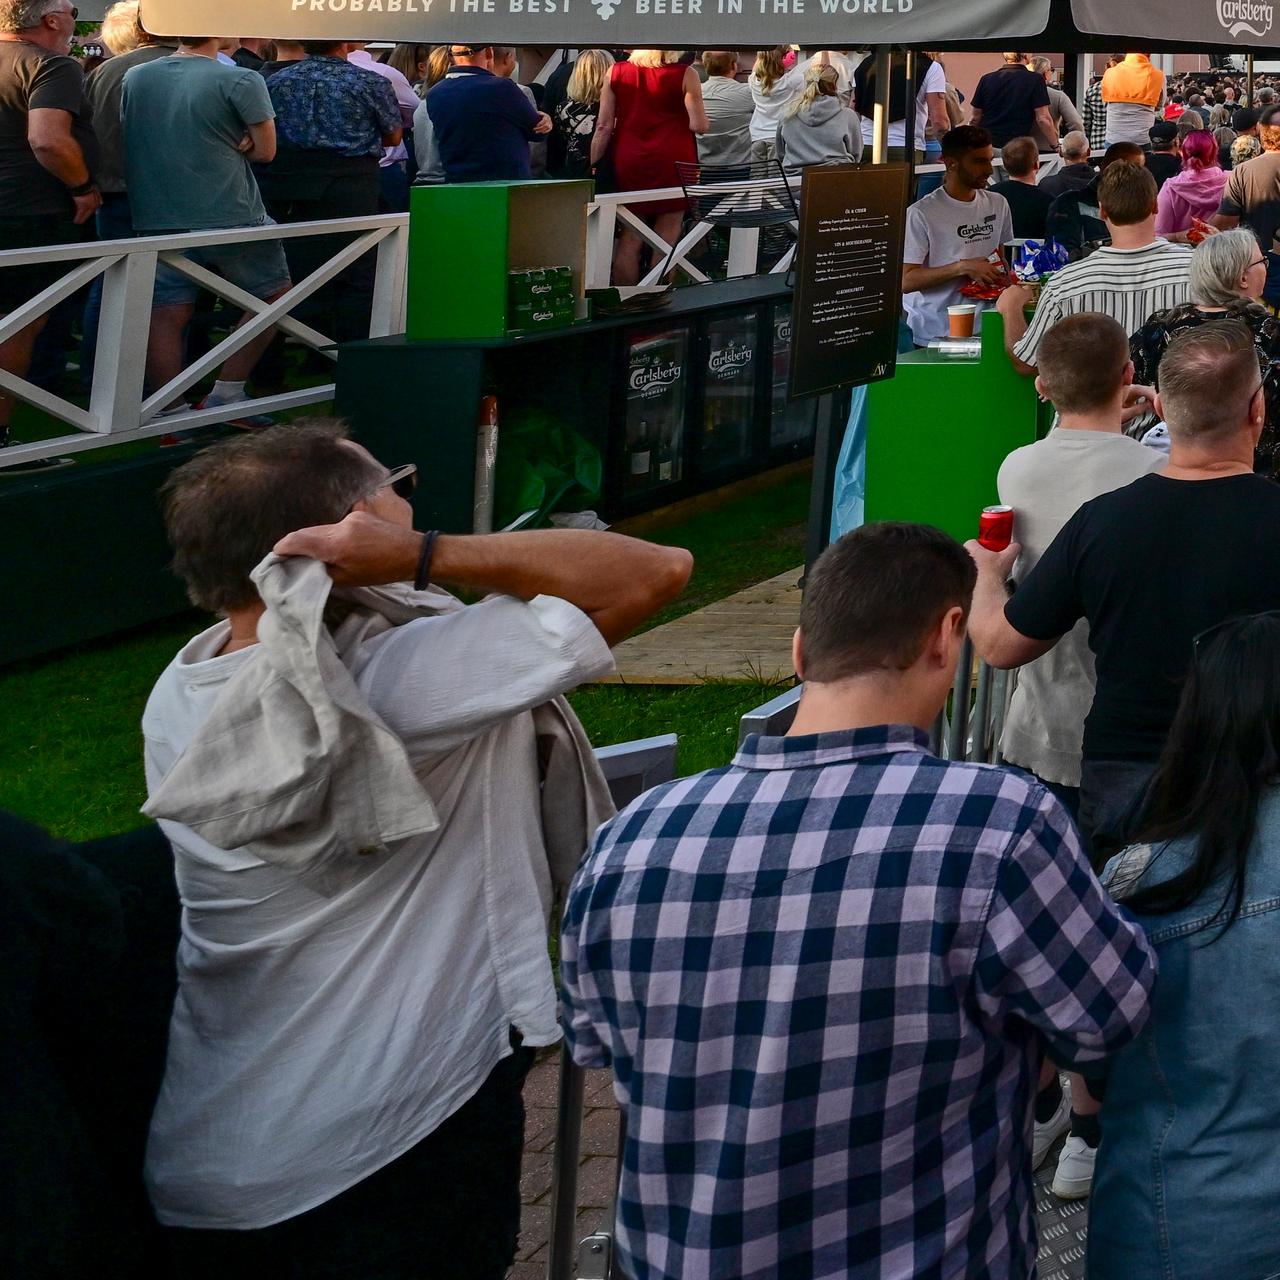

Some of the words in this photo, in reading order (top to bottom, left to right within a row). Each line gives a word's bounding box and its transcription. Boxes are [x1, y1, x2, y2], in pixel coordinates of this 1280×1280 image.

[957, 223, 994, 239] Carlsberg
[709, 346, 752, 373] Carlsberg
[630, 363, 681, 391] Carlsberg
